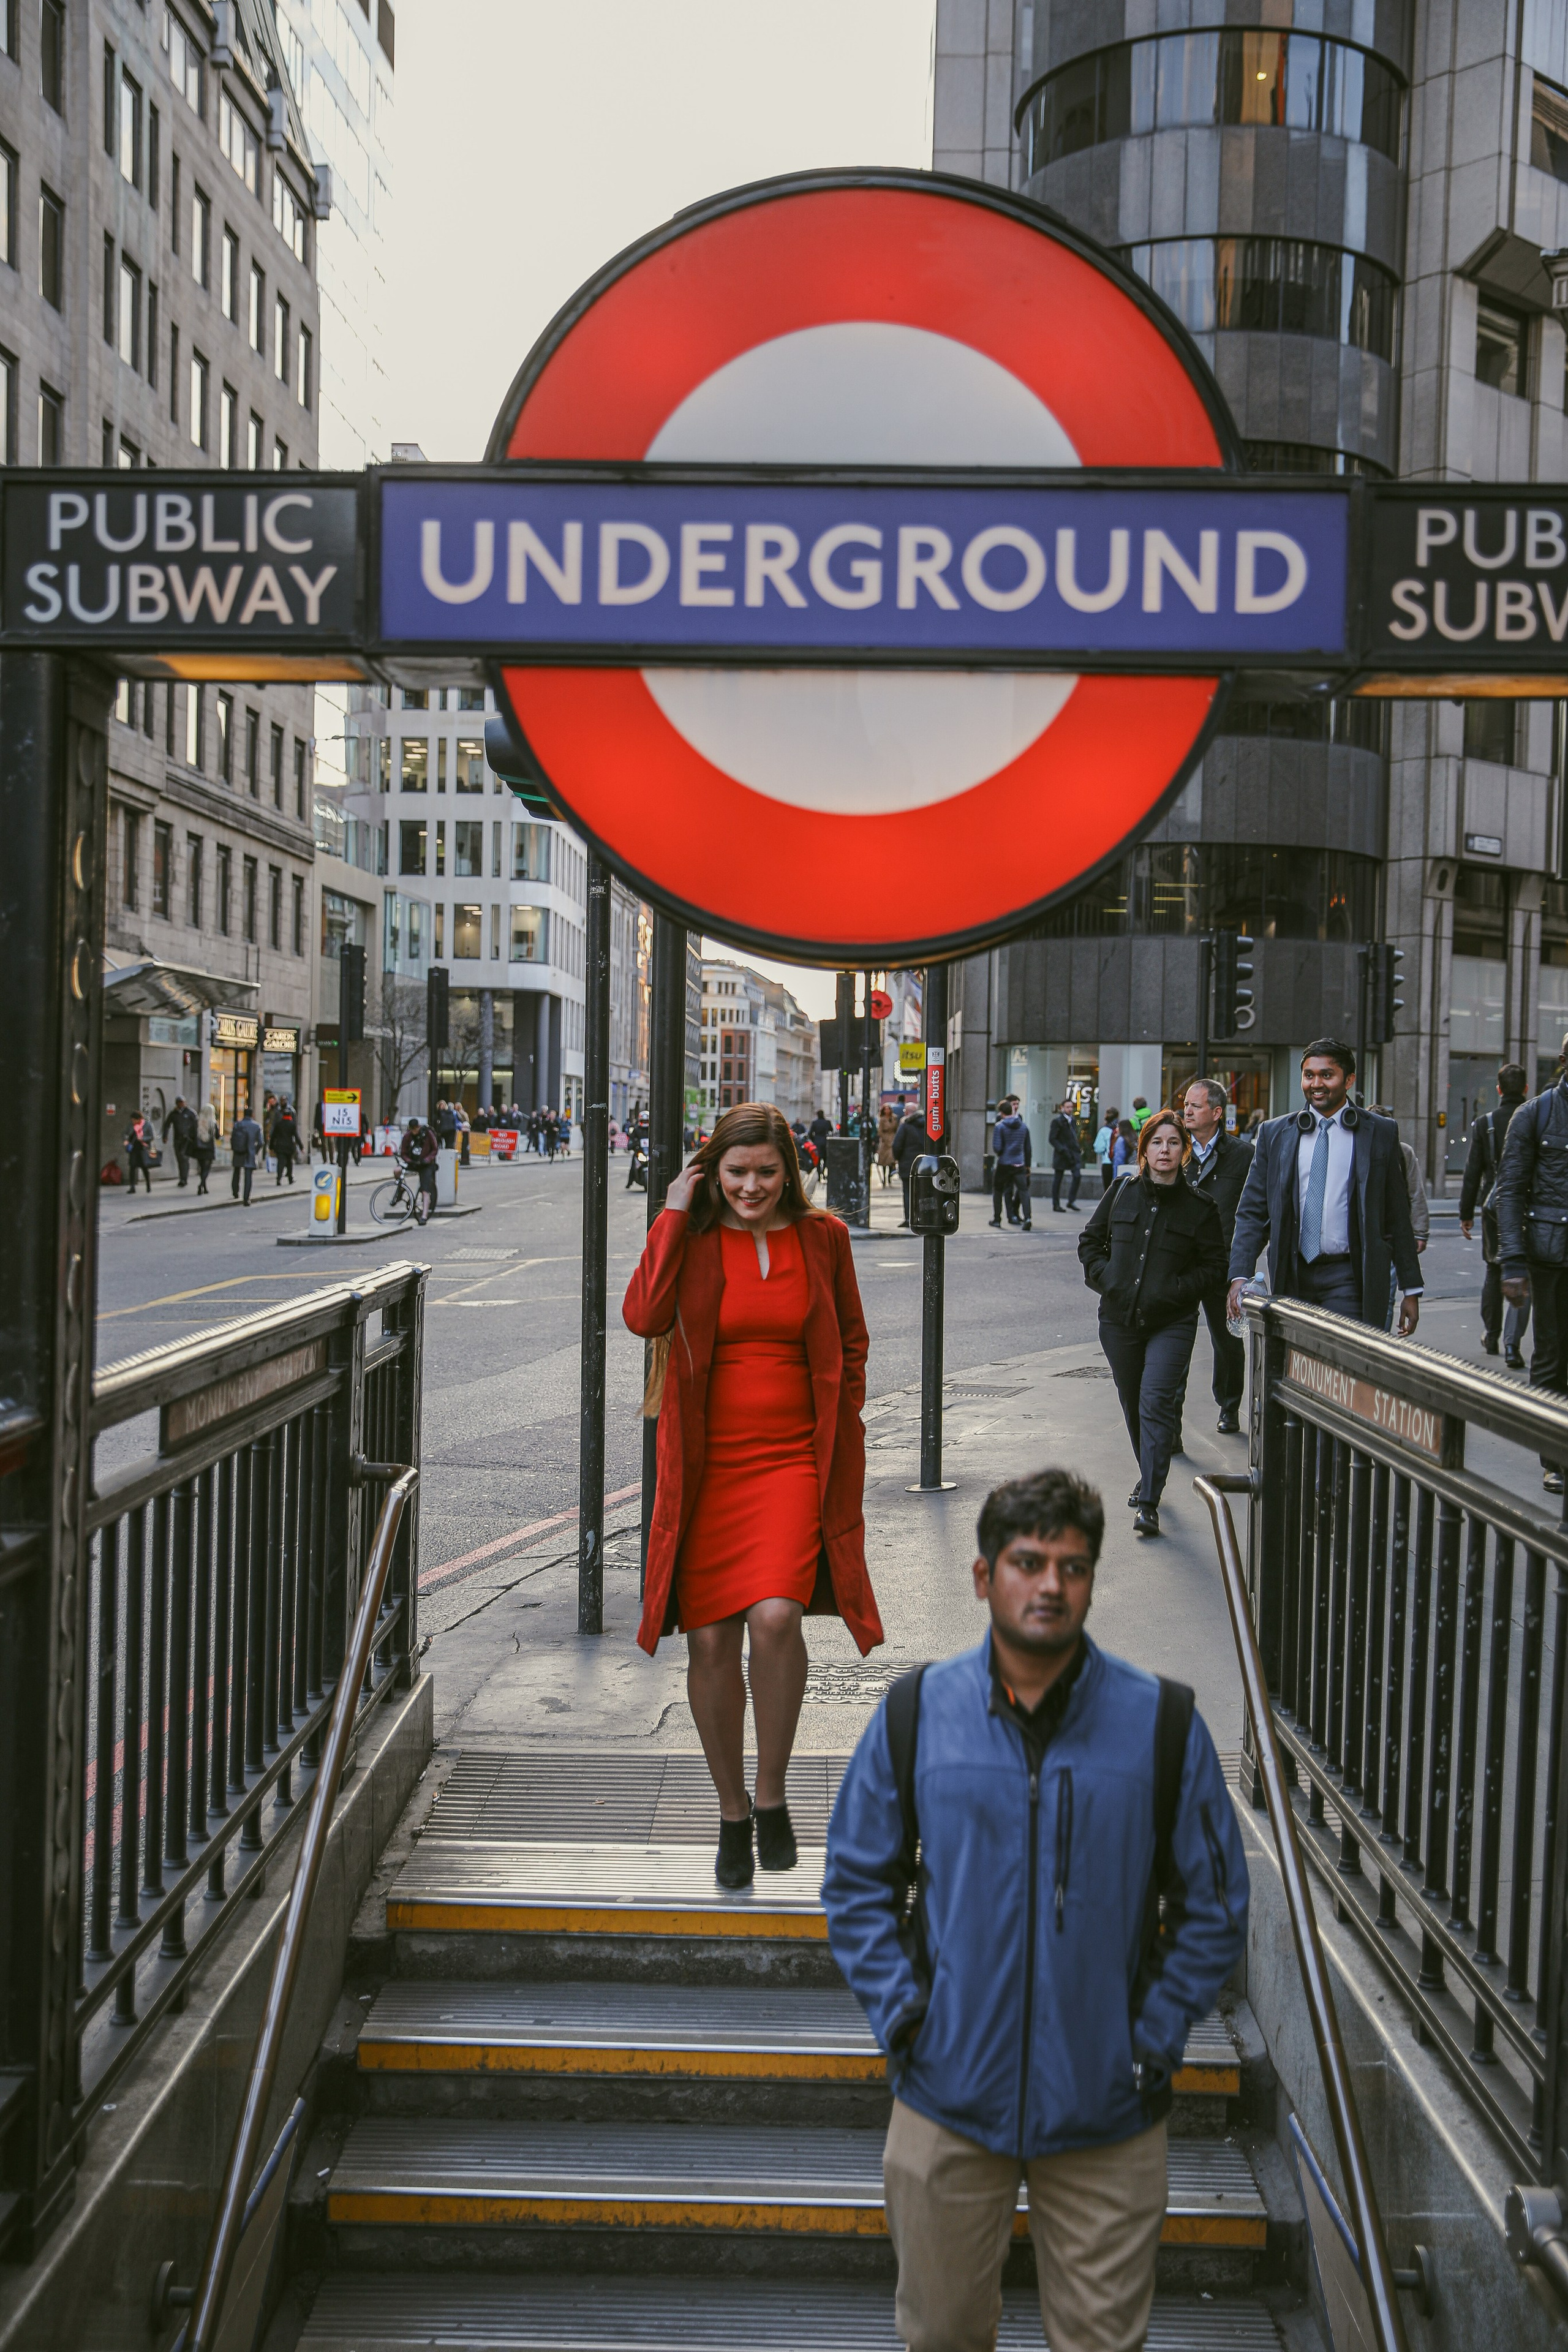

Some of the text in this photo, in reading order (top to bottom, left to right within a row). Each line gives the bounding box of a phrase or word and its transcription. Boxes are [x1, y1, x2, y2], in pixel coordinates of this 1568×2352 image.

[48, 493, 313, 554] PUBLIC
[24, 564, 337, 625] SUBWAY
[420, 520, 1307, 614] UNDERGROUND
[266, 1031, 295, 1040] CARDS
[902, 1049, 922, 1060] itsu
[186, 1344, 317, 1434] MONUMENT STATION
[1292, 1352, 1434, 1449] MONUMENT STATION
